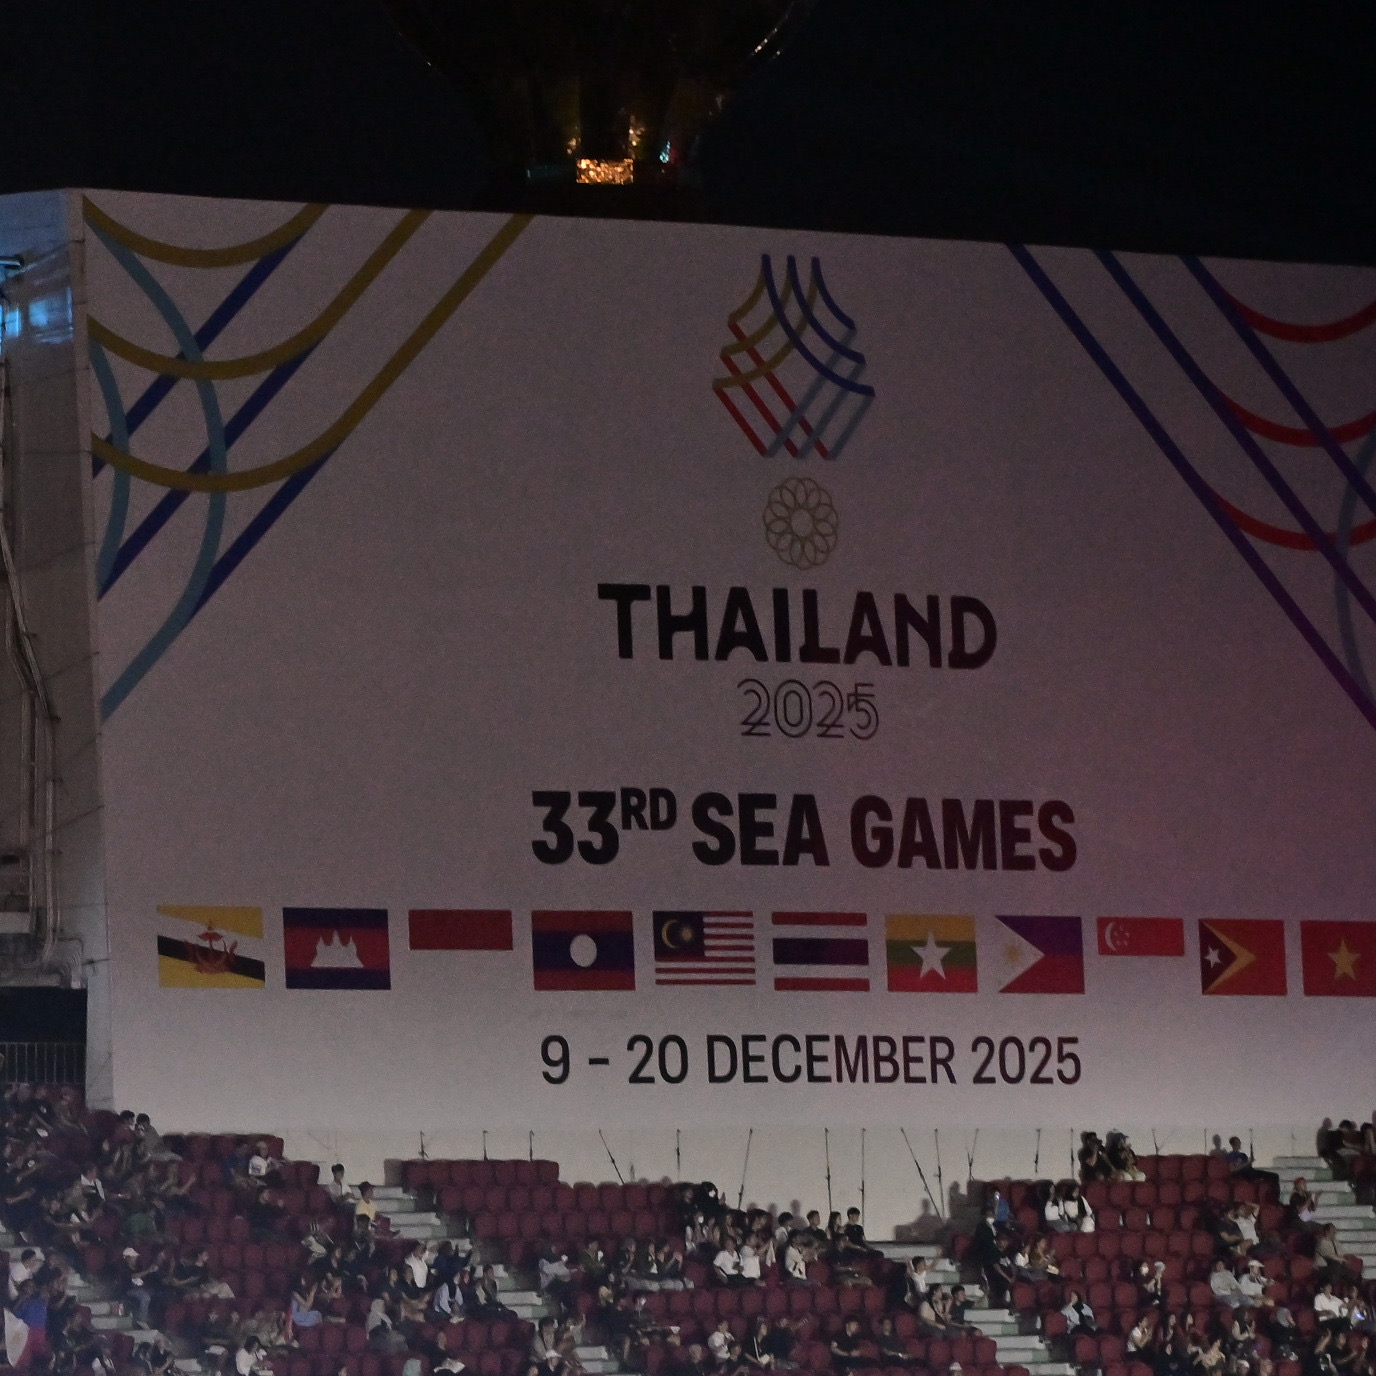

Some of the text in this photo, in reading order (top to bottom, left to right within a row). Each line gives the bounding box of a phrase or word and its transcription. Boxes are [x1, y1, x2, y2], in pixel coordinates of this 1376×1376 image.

[597, 583, 997, 670] THAILAND
[738, 678, 880, 740] 2025
[692, 792, 831, 867] SEA
[850, 795, 1077, 872] GAMES
[541, 1034, 571, 1085] 9
[627, 1034, 689, 1085] 20
[707, 1034, 957, 1085] DECEMBER
[972, 1035, 1082, 1086] 2025
